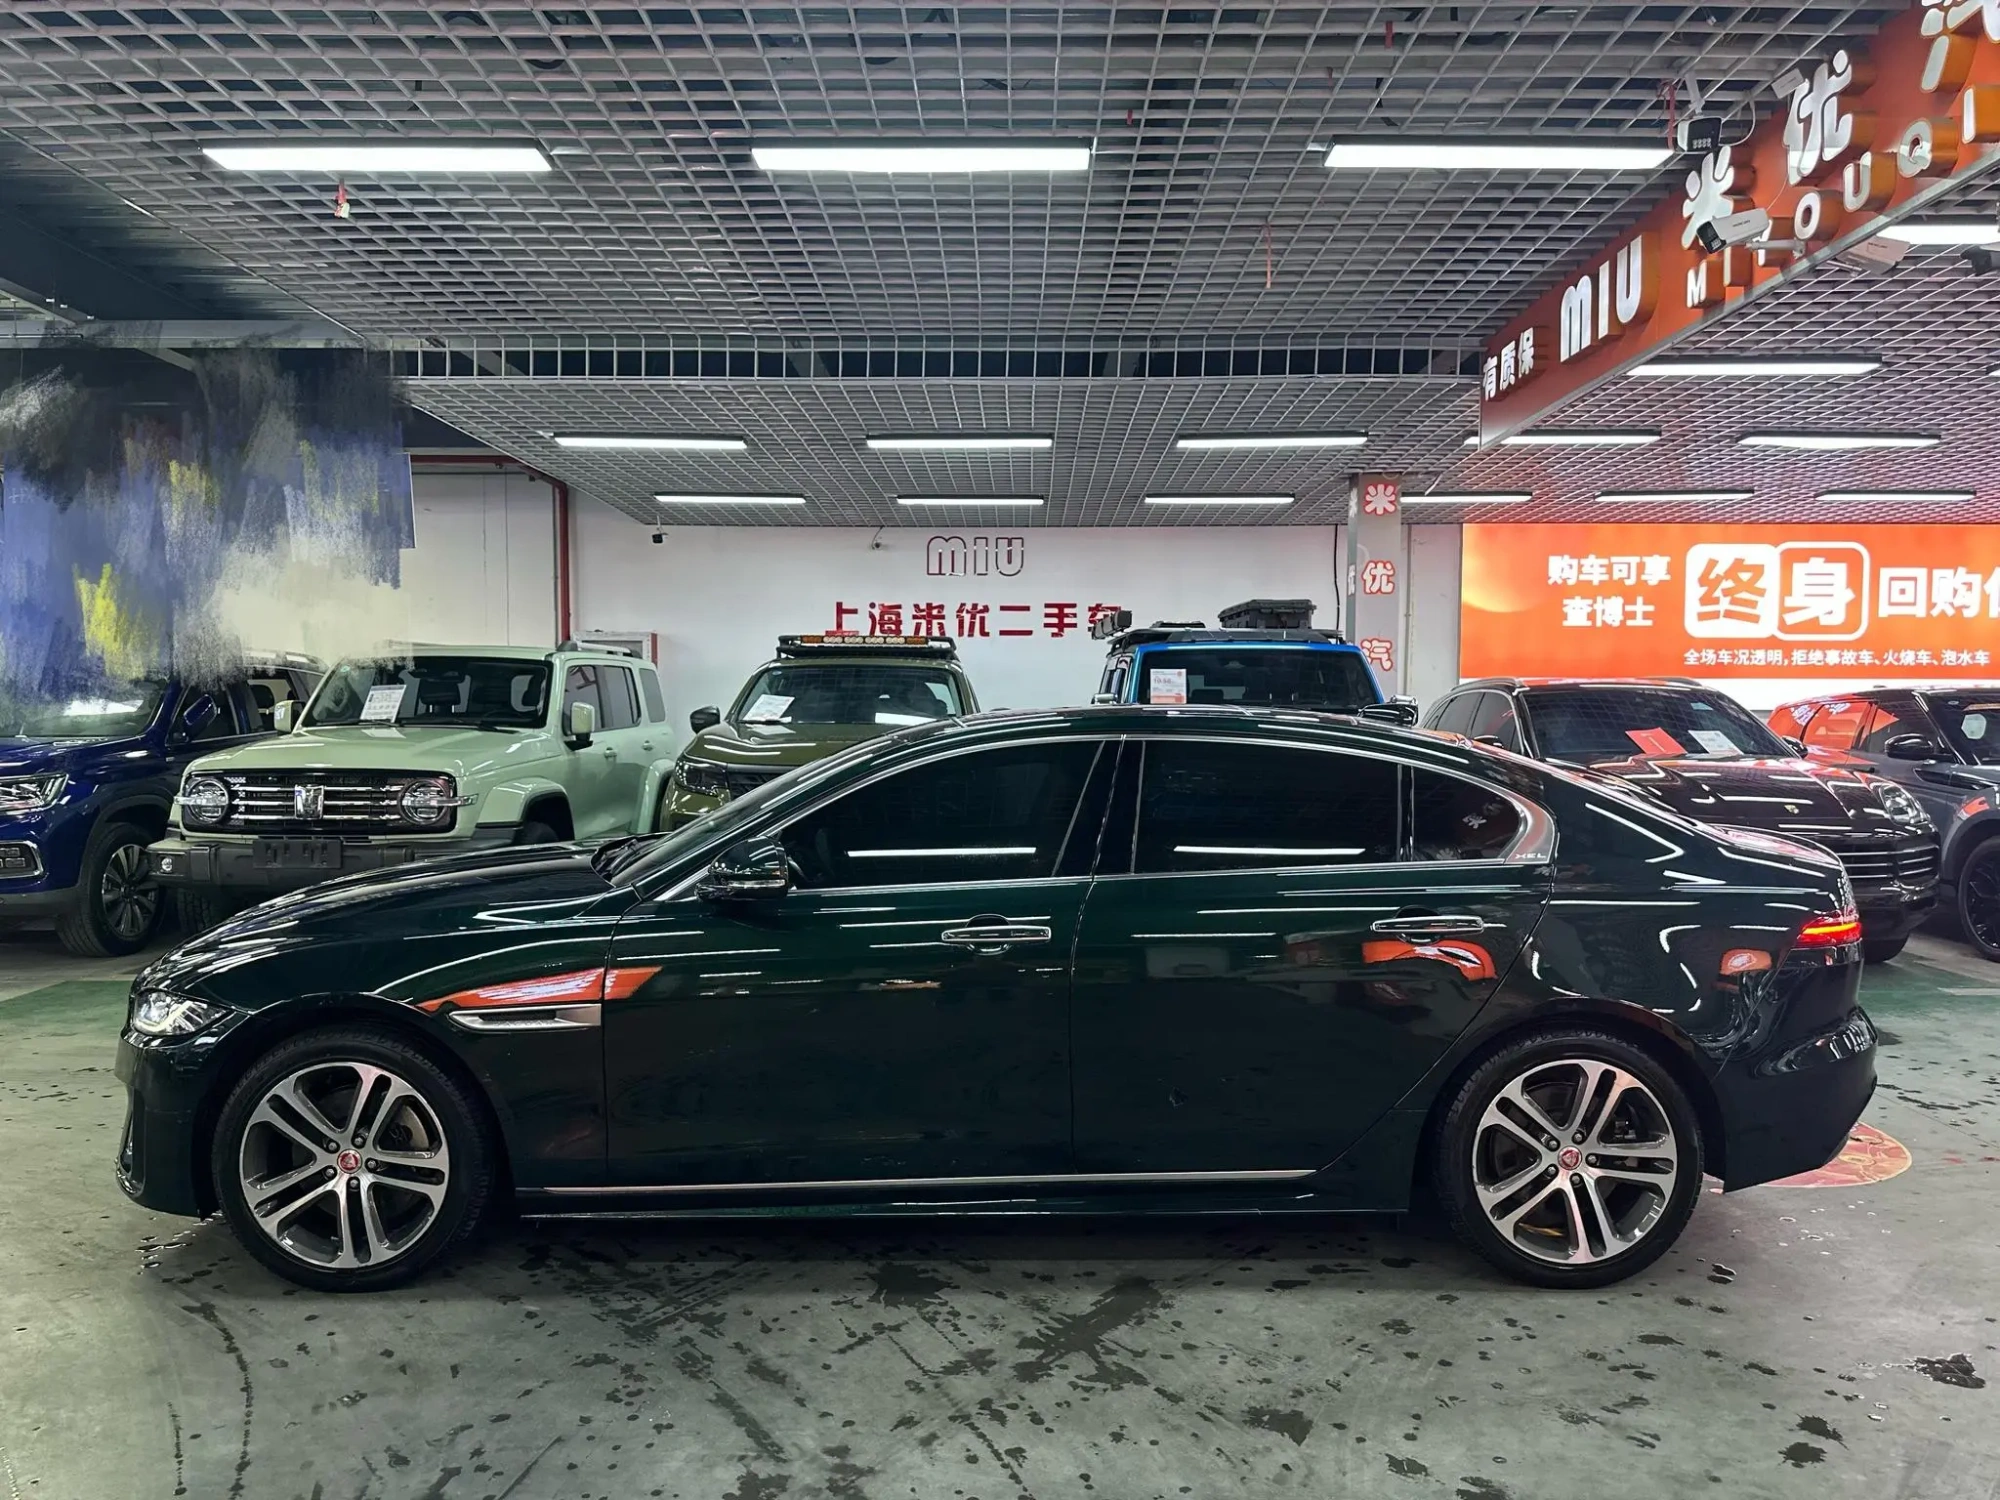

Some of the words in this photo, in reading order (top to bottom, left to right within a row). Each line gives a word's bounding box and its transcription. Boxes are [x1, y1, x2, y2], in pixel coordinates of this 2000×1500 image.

[1483, 327, 1534, 401] 有质保
[1547, 554, 1671, 586] 购车可享
[1562, 595, 1656, 627] 查博士
[1514, 852, 1547, 860] XEL
